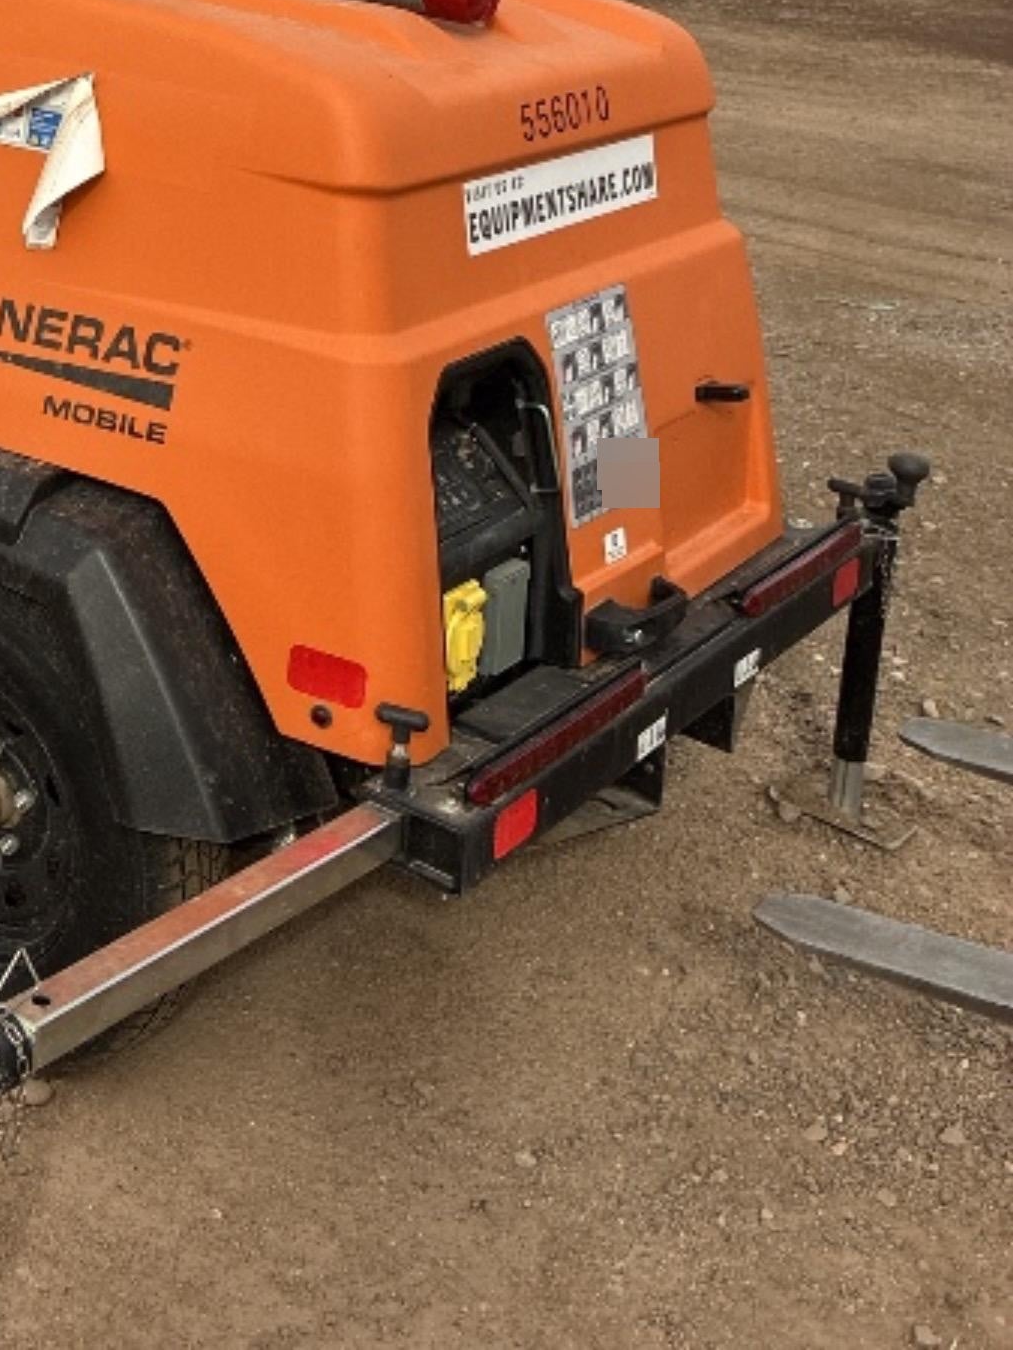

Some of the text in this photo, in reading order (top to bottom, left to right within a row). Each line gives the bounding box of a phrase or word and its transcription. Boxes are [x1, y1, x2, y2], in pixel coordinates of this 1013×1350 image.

[520, 85, 610, 142] 556010
[468, 161, 654, 244] EQUIPMENTSHARE.COM
[41, 395, 168, 445] MOBILE
